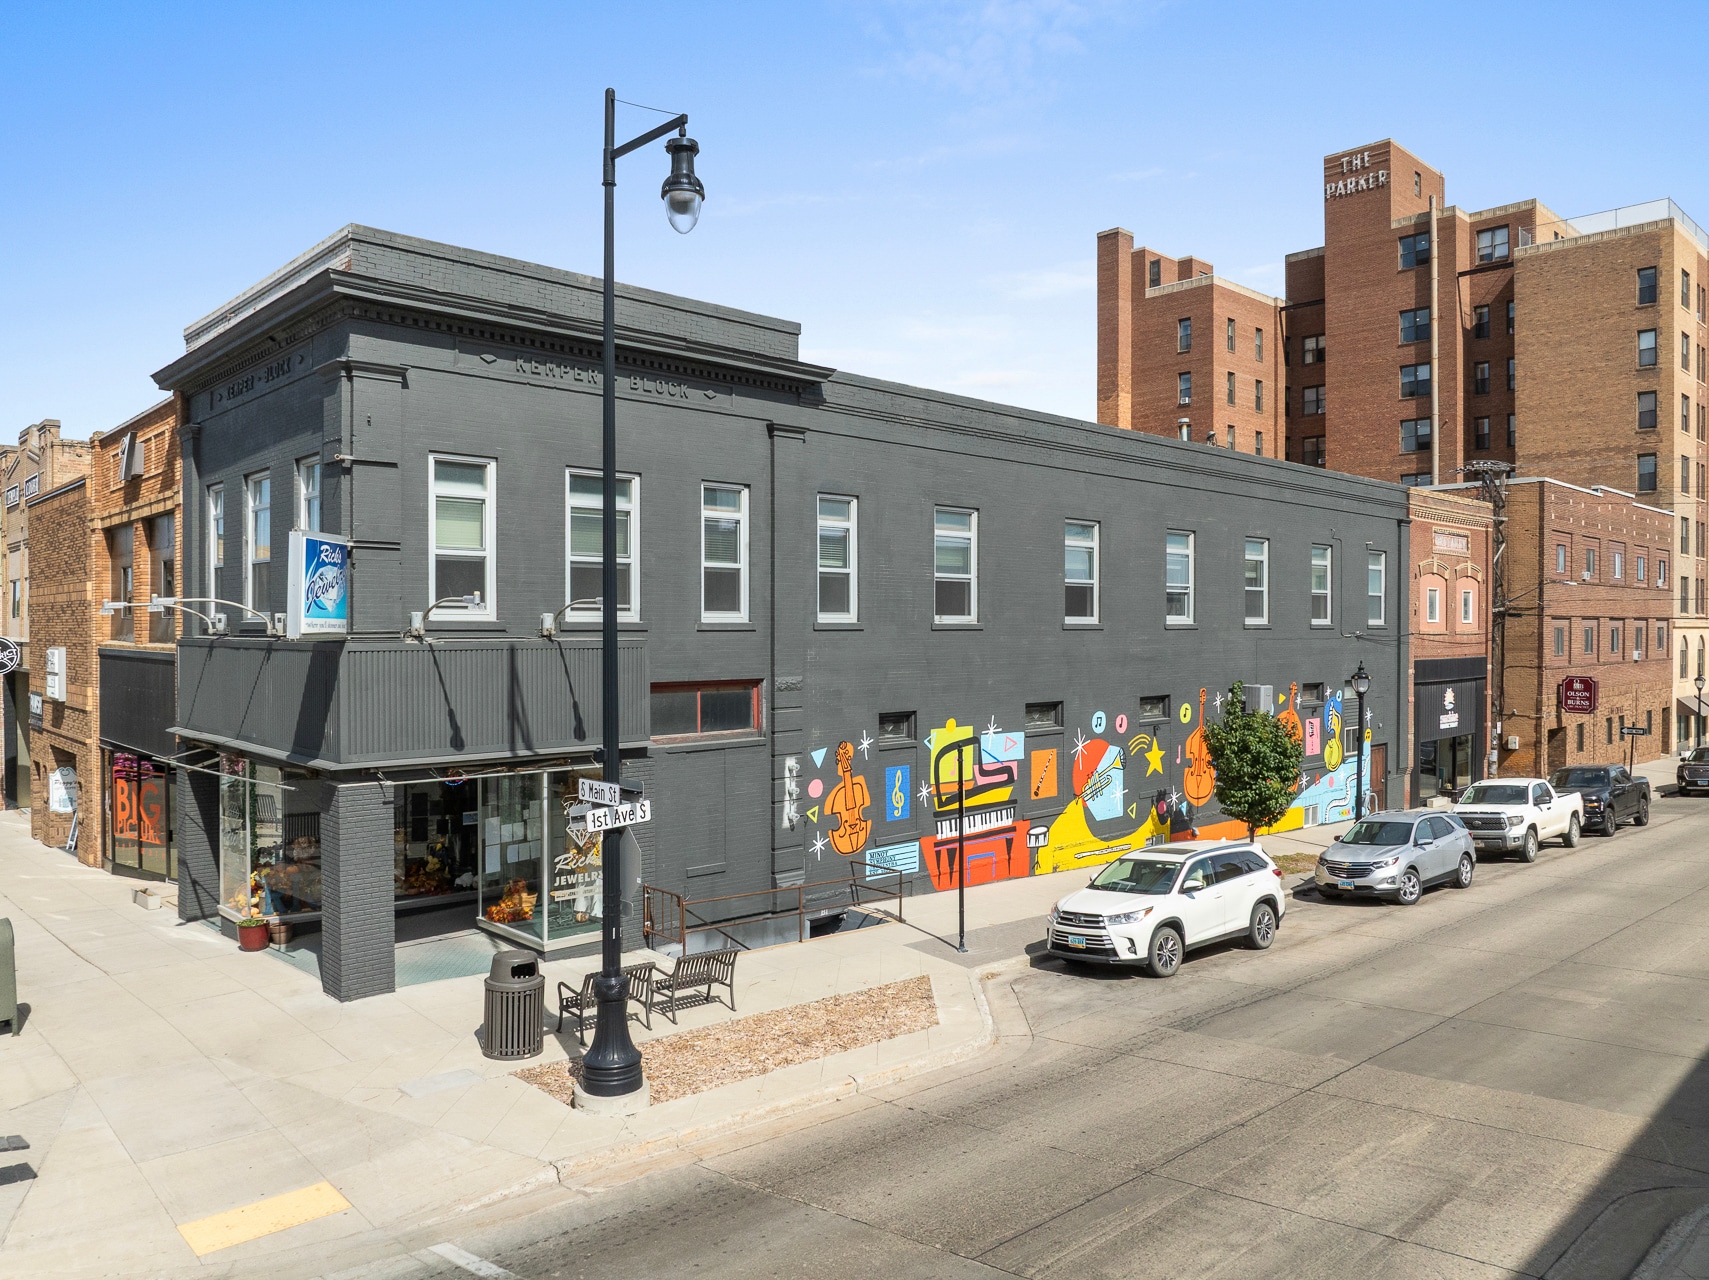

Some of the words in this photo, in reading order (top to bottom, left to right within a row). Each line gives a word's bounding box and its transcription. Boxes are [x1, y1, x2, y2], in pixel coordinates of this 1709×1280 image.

[1340, 151, 1371, 173] THE
[1326, 170, 1388, 199] PARKER
[264, 356, 292, 384] BLOCK
[515, 358, 599, 385] KEMPER
[629, 375, 689, 399] BLOCK
[319, 544, 342, 564] Rick's
[117, 778, 161, 827] BIG
[581, 781, 586, 798] S
[588, 782, 605, 801] Main
[608, 786, 617, 803] St
[592, 811, 609, 828] 1st
[614, 808, 635, 825] Ave
[640, 803, 646, 819] S
[117, 819, 161, 845] PICURE
[869, 850, 888, 859] MINOT
